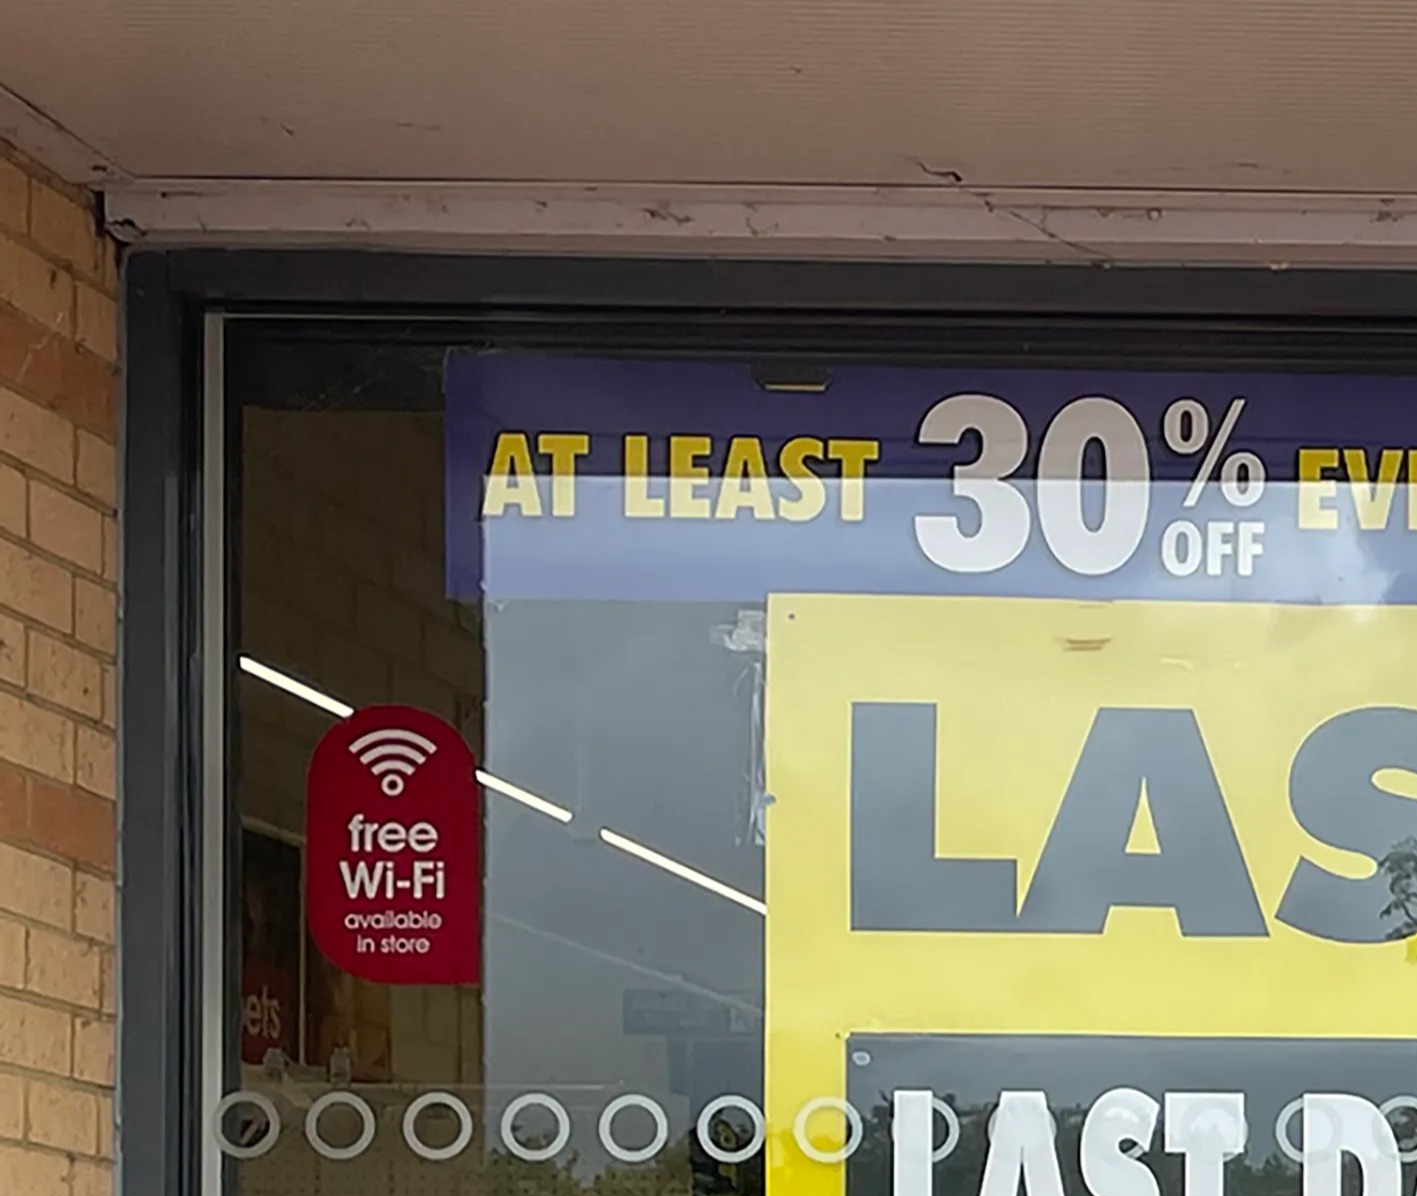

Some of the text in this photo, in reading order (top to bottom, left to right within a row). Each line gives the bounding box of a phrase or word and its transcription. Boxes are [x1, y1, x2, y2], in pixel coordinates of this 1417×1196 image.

[482, 431, 589, 518] AT
[624, 436, 880, 522] LEAST
[1160, 520, 1265, 577] OFF
[347, 813, 439, 853] free
[339, 860, 445, 900] Wi-Fi
[344, 910, 443, 930] available
[356, 934, 431, 954] in store
[244, 984, 281, 1040] ets
